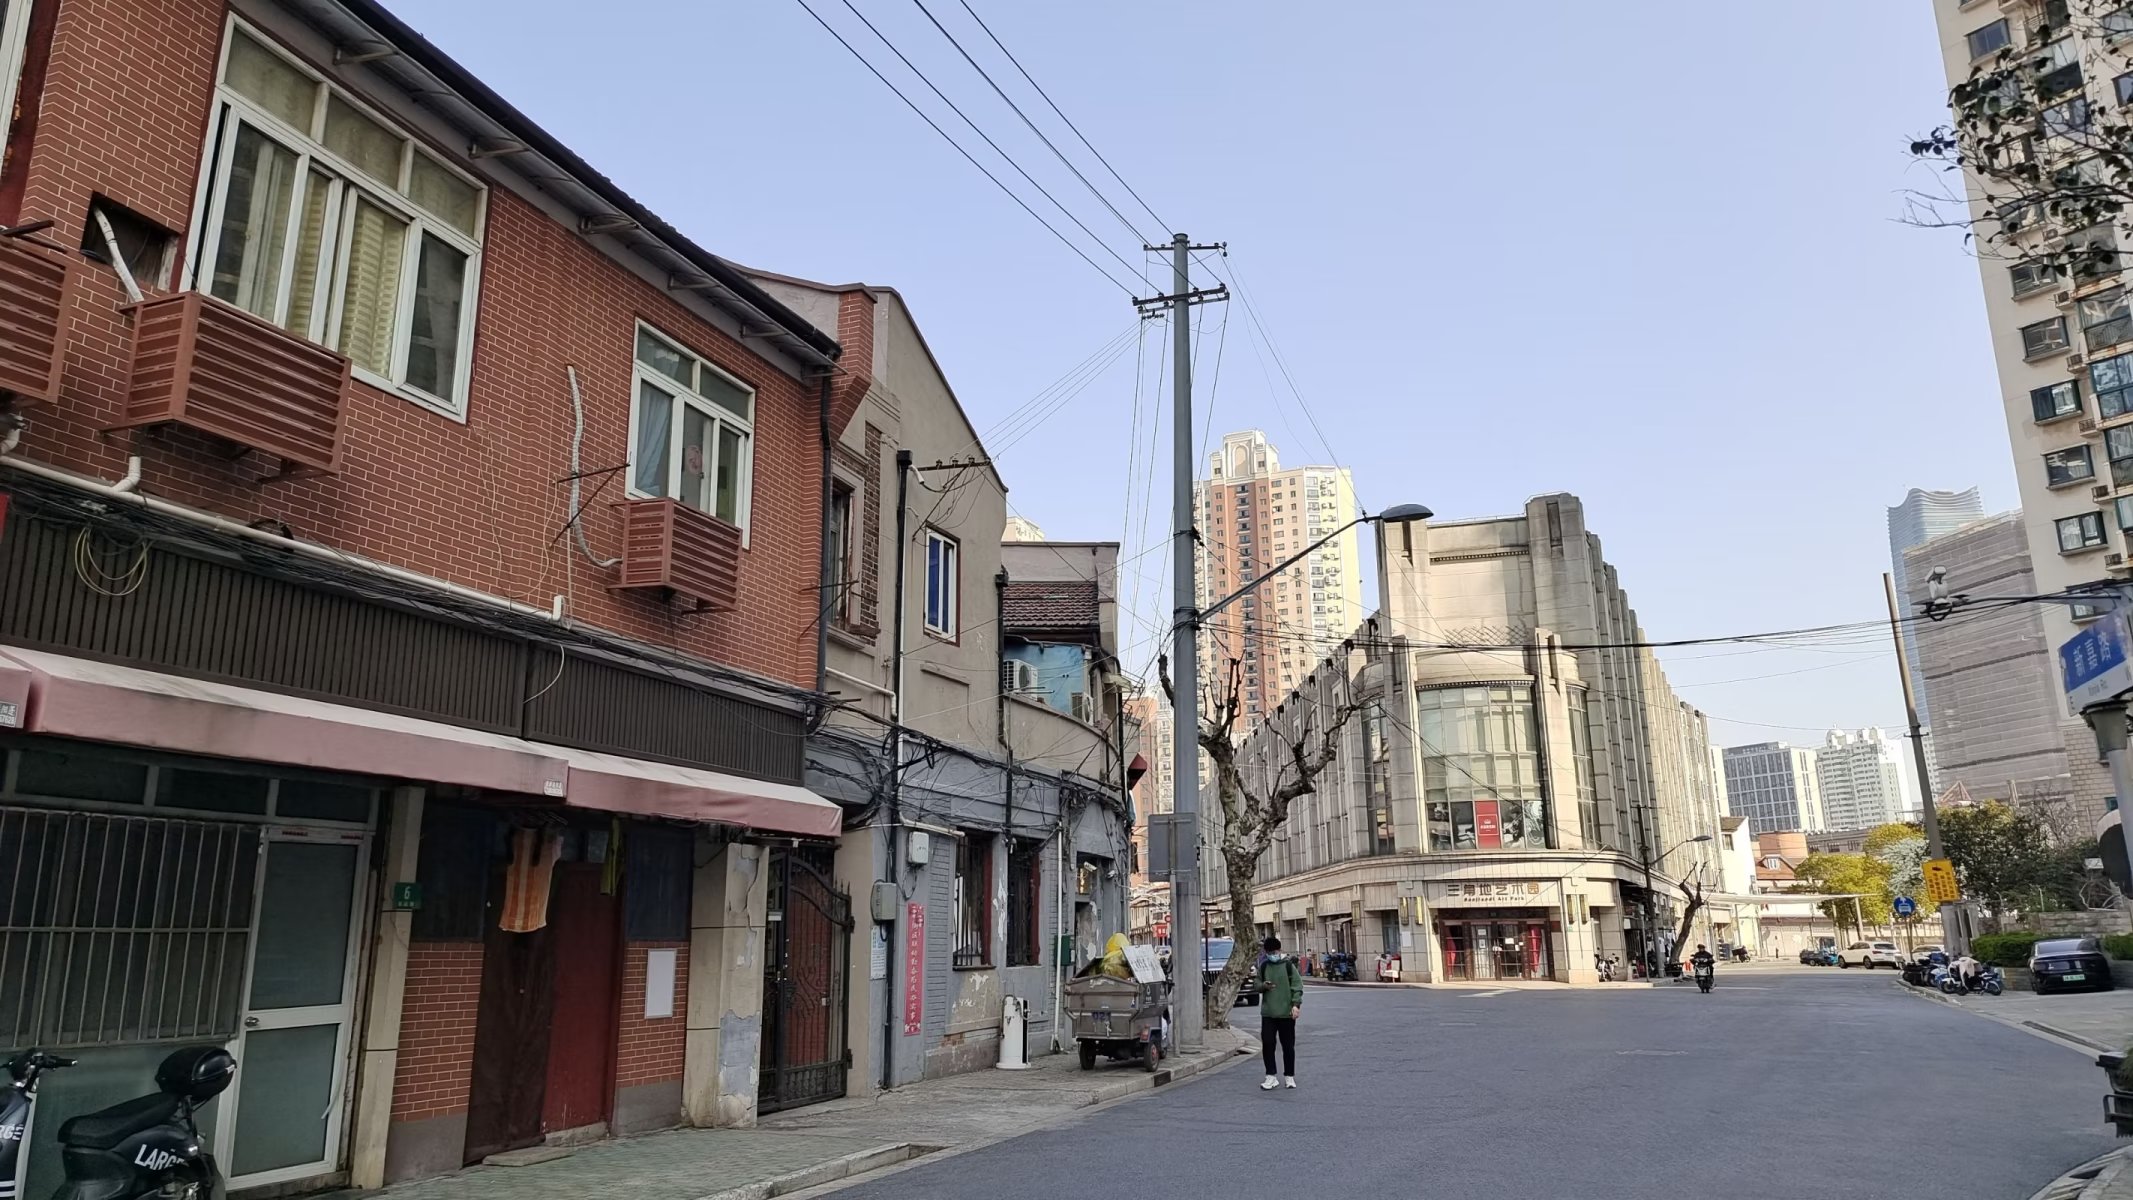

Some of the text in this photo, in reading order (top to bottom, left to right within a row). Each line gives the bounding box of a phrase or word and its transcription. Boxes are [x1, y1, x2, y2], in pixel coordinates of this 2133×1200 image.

[404, 885, 411, 900] 6
[1447, 882, 1539, 896] 三角地艺术园
